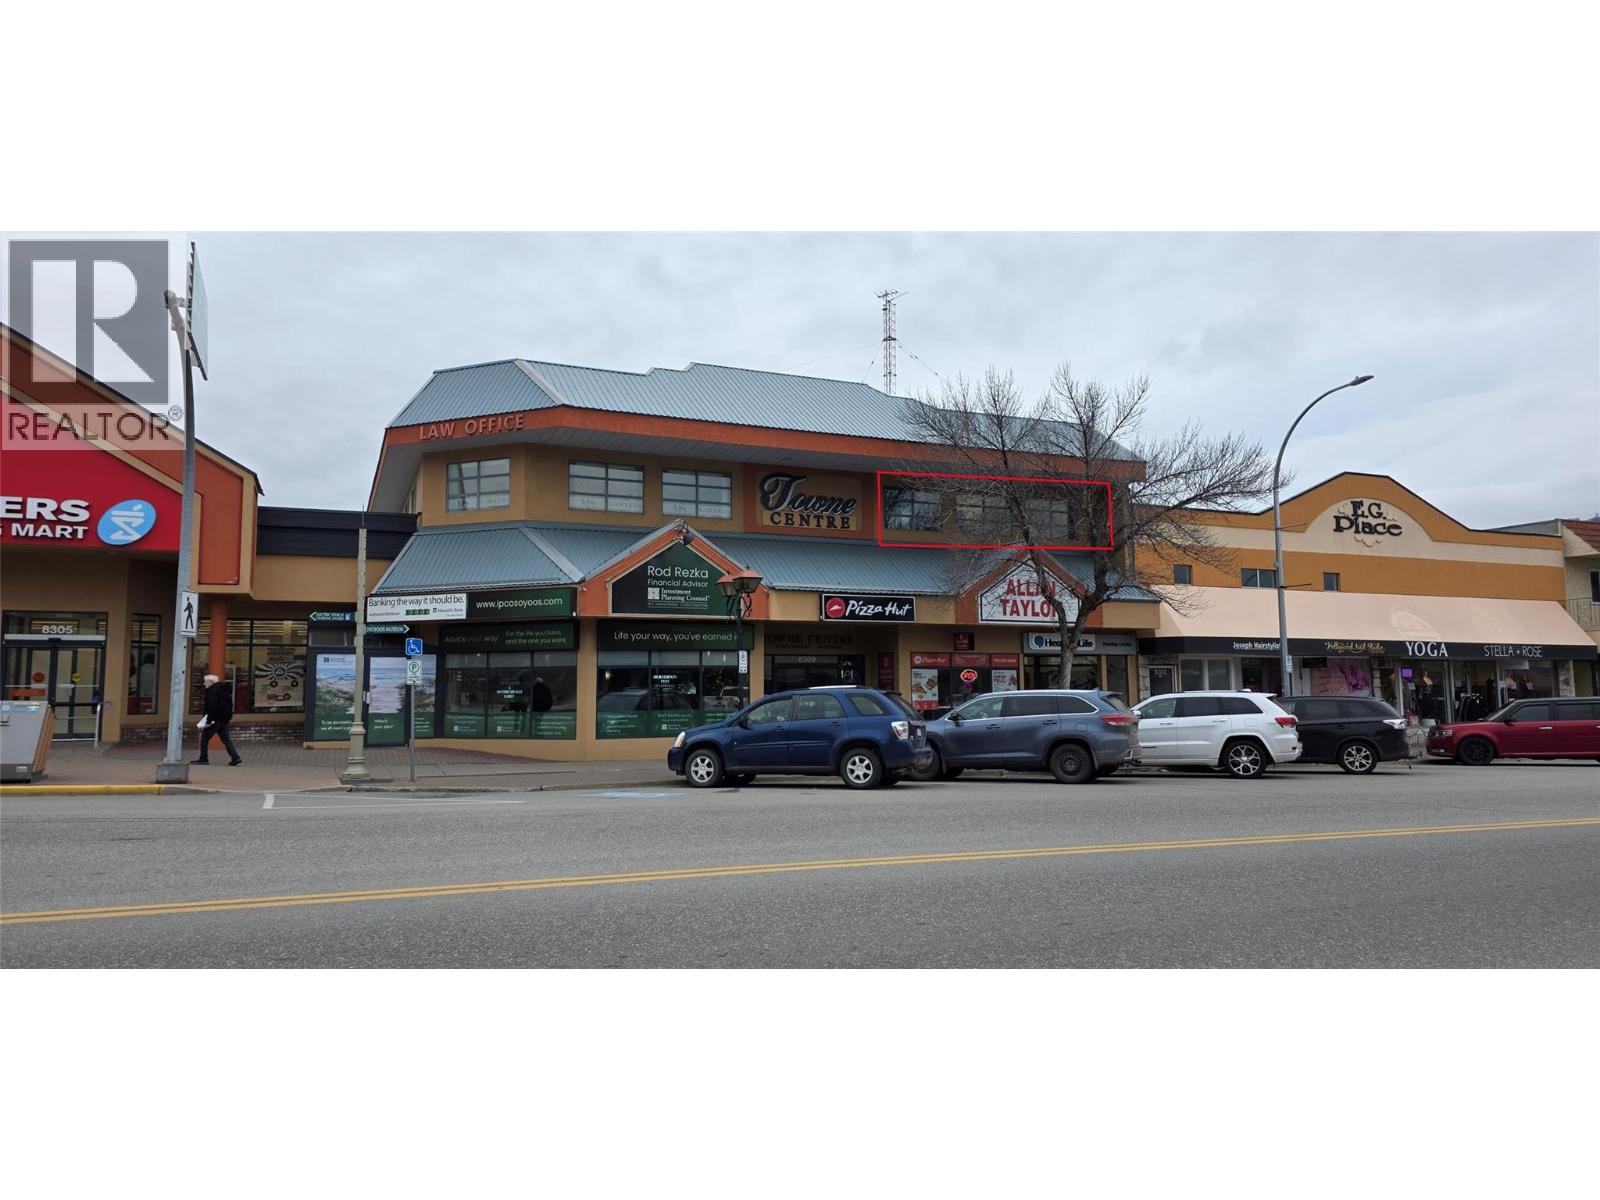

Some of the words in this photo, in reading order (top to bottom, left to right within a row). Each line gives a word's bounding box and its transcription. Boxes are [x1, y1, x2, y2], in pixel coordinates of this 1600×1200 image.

[420, 422, 455, 440] LAW
[464, 414, 524, 435] OFFICE
[759, 472, 857, 515] Towne
[0, 496, 90, 522] ERS
[769, 511, 851, 529] CENTRE
[1333, 515, 1403, 537] Place
[11, 523, 89, 539] MART
[647, 565, 671, 577] Rod
[674, 566, 709, 579] Rezka
[647, 579, 680, 587] Financial
[682, 580, 709, 588] Advisor
[661, 587, 691, 595] Investment
[368, 597, 396, 608] Banking
[396, 596, 408, 606] the
[409, 597, 422, 607] way
[423, 597, 428, 605] it
[429, 595, 452, 604] should
[475, 598, 563, 610] www.ipcosoyoos.com
[661, 594, 686, 602] Planning
[845, 600, 883, 616] Pizza
[884, 601, 913, 616] Hut
[42, 624, 73, 634] 8305
[613, 631, 629, 640] Life
[630, 633, 651, 642] your
[651, 633, 672, 643] way,
[674, 632, 701, 643] you've
[702, 632, 733, 641] earned
[1232, 641, 1253, 650] Joseph
[1253, 641, 1281, 650] Hairstylis
[1405, 641, 1449, 657] YOGA
[1483, 645, 1514, 657] STELLA
[1522, 646, 1542, 657] ROSE
